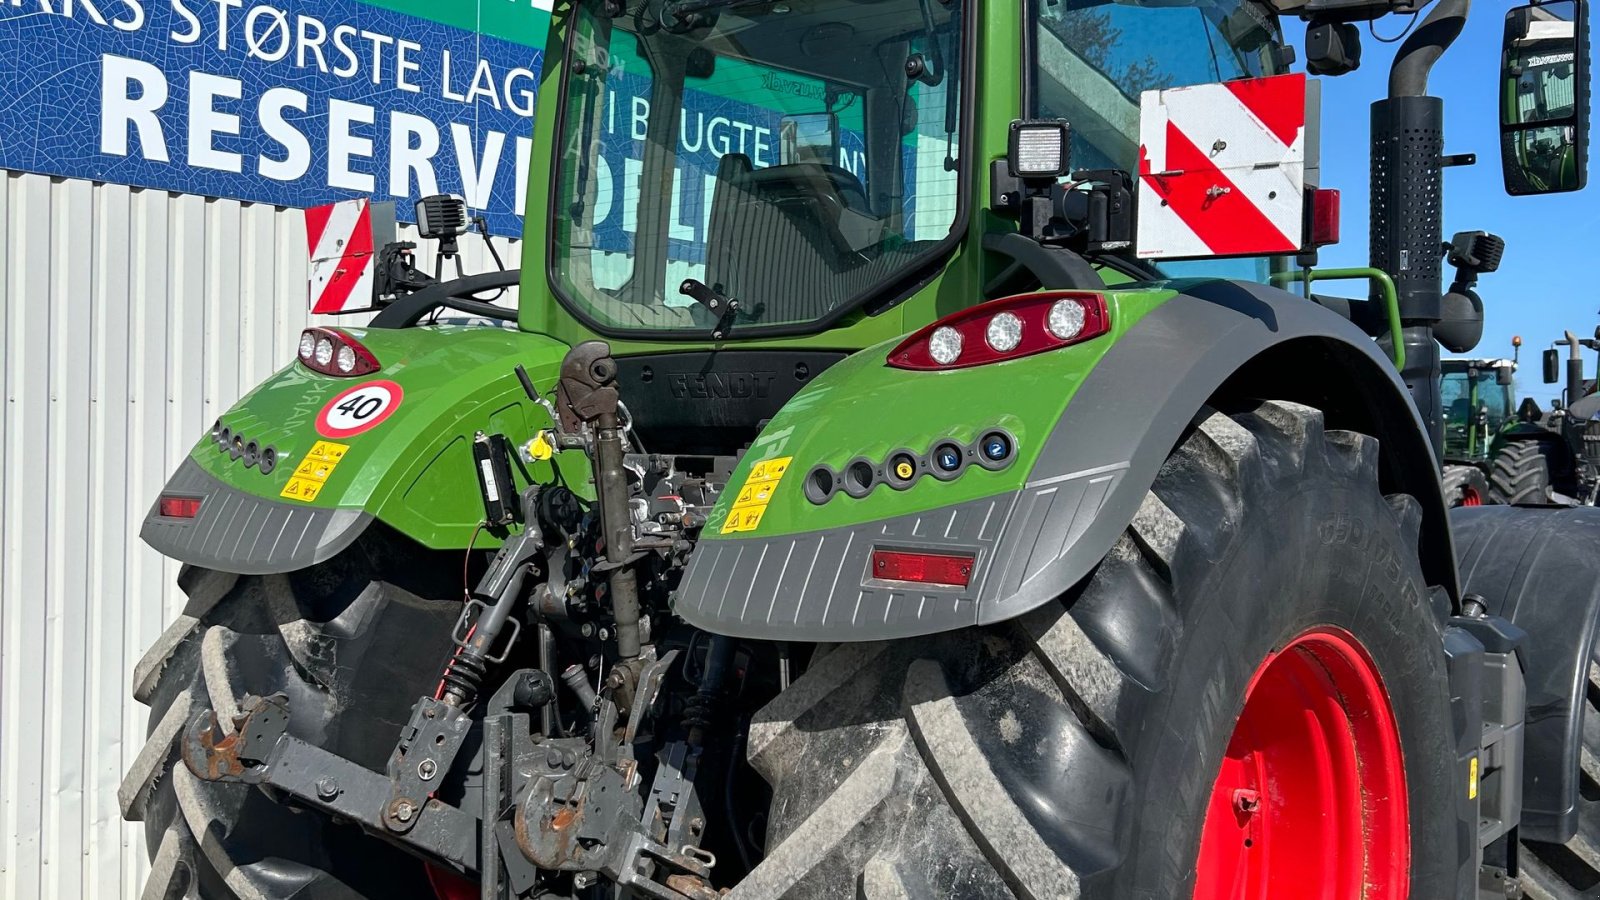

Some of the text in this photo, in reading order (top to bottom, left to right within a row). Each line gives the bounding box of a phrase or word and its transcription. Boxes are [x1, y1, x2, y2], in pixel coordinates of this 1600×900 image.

[171, 0, 421, 92] STØRSTE
[442, 49, 534, 117] LAG
[631, 96, 770, 168] BUGTE
[666, 371, 776, 399] FENDT
[336, 394, 383, 420] 40
